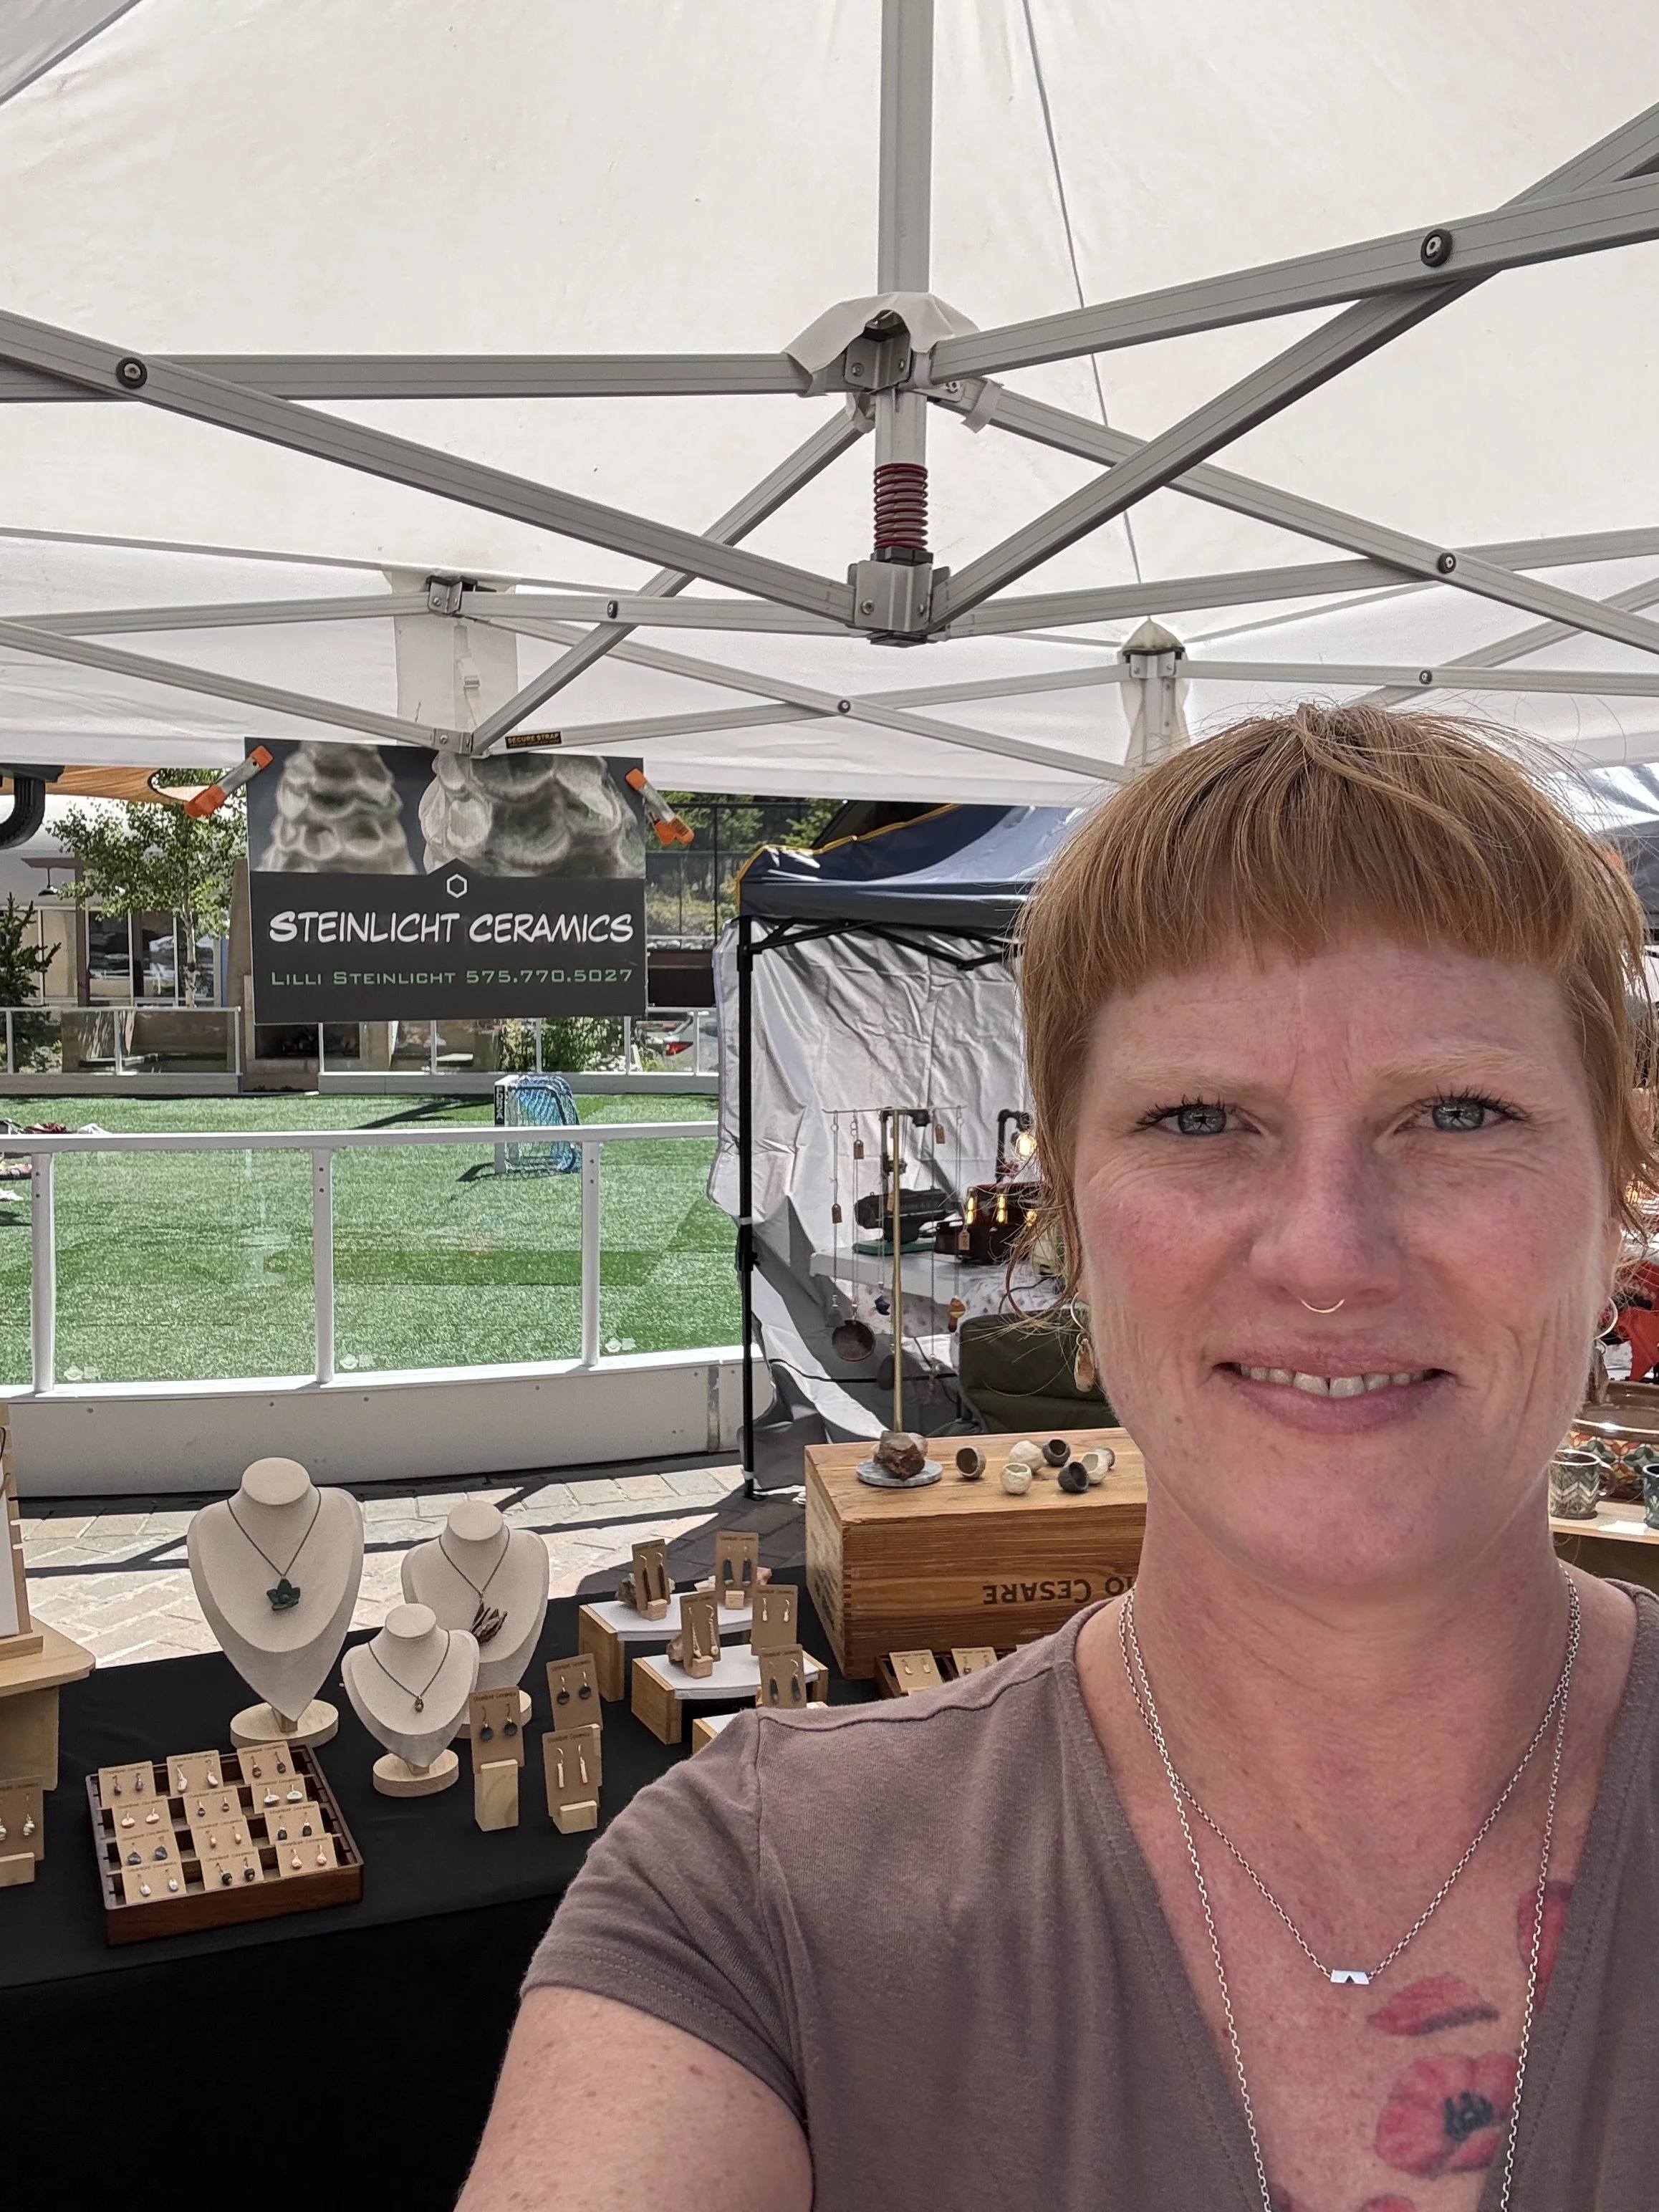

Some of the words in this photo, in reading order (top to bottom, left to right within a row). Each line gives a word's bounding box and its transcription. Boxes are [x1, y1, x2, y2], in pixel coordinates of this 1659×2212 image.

[508, 736, 536, 744] SECURE
[269, 911, 460, 943] STEINLICHT
[469, 913, 633, 943] CERAMICS
[271, 971, 322, 985] LILLI
[333, 971, 456, 984] STEINLICHT
[466, 969, 633, 984] 575.770.5027
[983, 1579, 1092, 1605] CESARE
